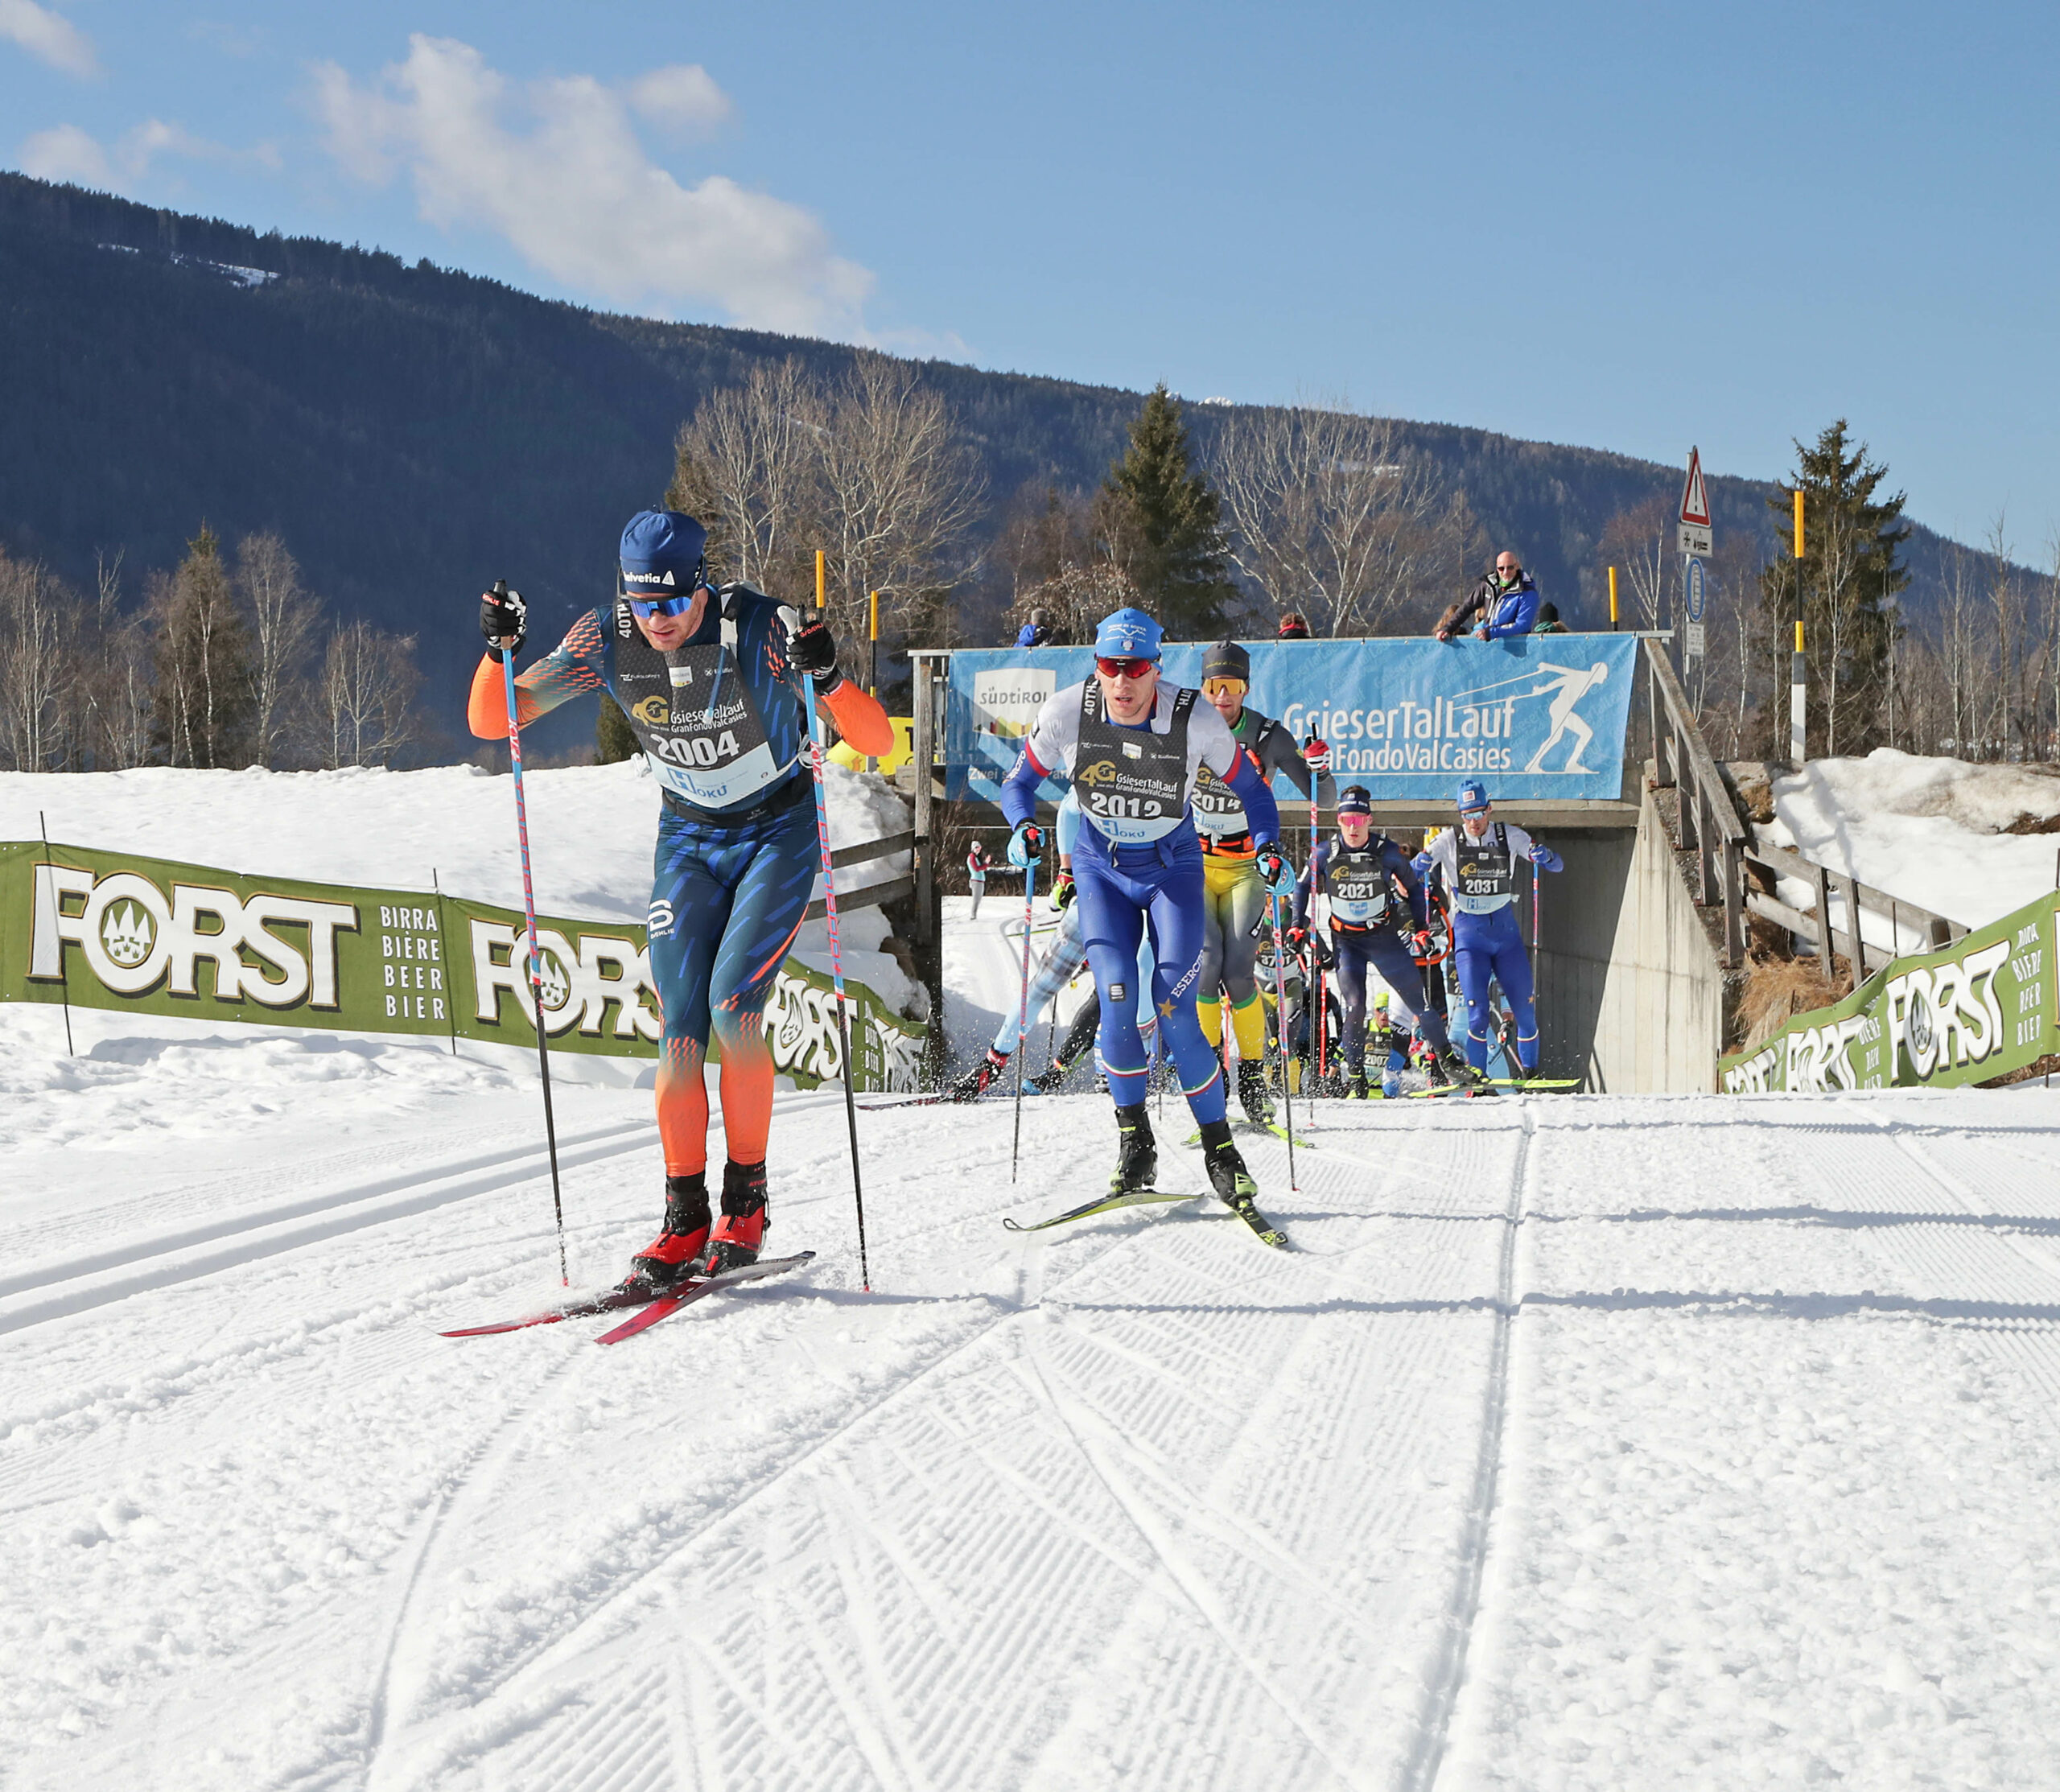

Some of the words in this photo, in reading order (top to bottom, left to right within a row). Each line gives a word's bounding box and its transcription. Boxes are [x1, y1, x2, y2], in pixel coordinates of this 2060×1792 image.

[670, 698, 745, 724] GsiesealLauf
[1283, 695, 1516, 740] GsieserTalLauf
[650, 729, 740, 766] 2004
[969, 768, 998, 781] Zwei
[1116, 772, 1178, 793] GsieserTalLauf
[1191, 788, 1241, 813] 2014
[1337, 882, 1374, 899] 2021
[1465, 879, 1498, 894] 2031
[378, 904, 438, 933] BIRRA
[27, 862, 360, 1011] FORST
[381, 929, 441, 962] BIÈRE
[1261, 954, 1292, 966] 371
[384, 965, 443, 991] BEER
[470, 917, 663, 1040] FOR
[385, 994, 446, 1020] BIER
[1886, 938, 2012, 1085] FORST
